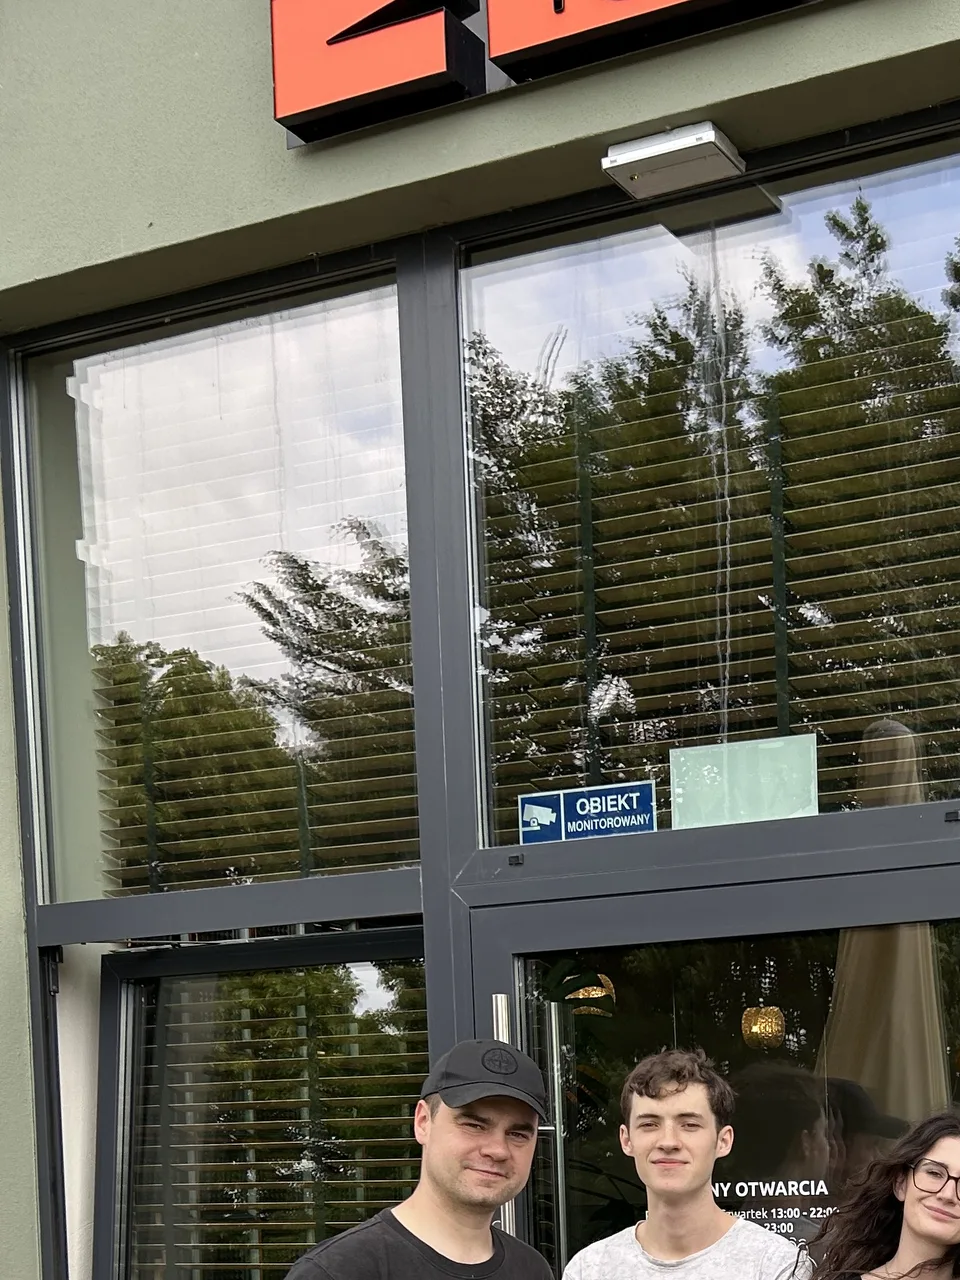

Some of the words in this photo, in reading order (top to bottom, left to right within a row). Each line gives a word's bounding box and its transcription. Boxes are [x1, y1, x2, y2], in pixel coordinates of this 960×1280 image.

[576, 792, 641, 816] OBIEKT
[567, 813, 651, 833] MONITOROWANY
[735, 1180, 829, 1198] OTWARCIA
[771, 1208, 800, 1219] 13:00
